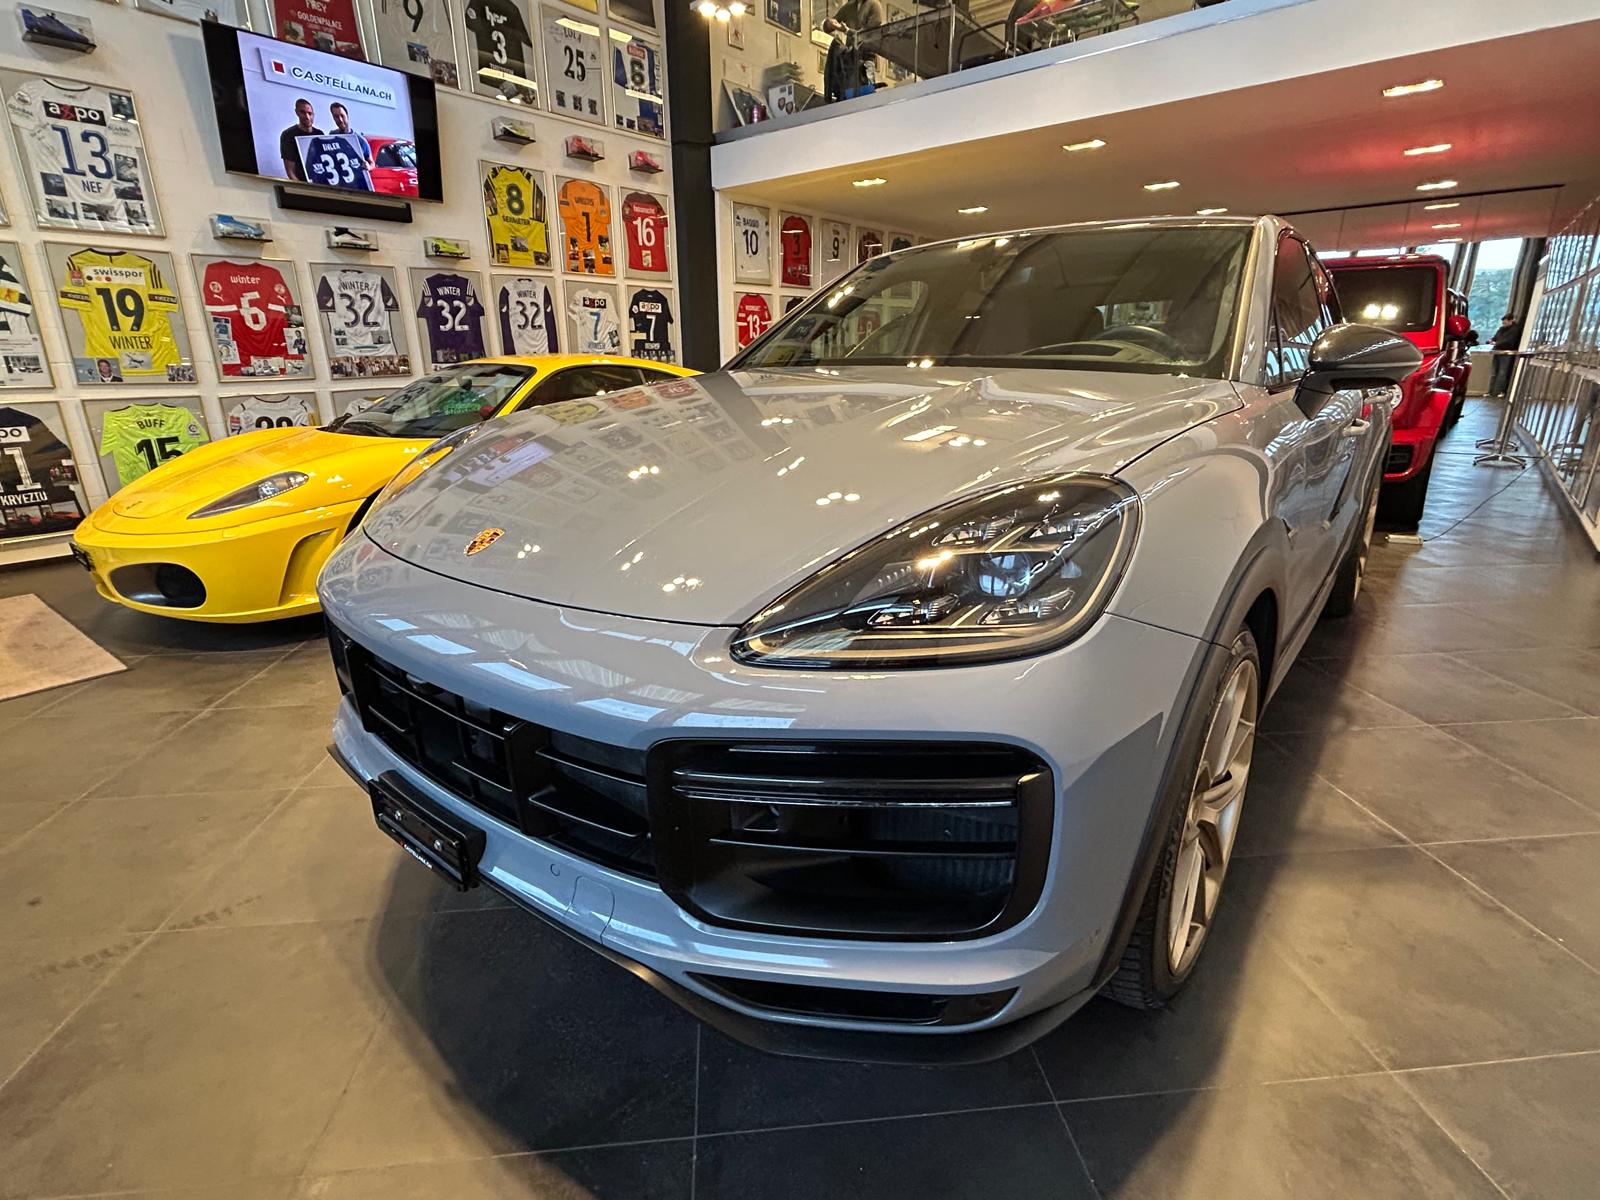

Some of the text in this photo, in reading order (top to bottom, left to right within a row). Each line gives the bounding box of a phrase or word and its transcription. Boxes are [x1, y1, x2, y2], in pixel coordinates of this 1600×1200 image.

[491, 31, 508, 64] 3
[564, 45, 586, 82] 25
[292, 67, 392, 101] CASTELLANA.CH
[51, 124, 115, 179] 13
[321, 152, 355, 185] 33
[82, 180, 103, 193] NEF
[506, 183, 525, 216] 8
[582, 211, 592, 242] 1
[633, 217, 656, 247] 16
[742, 229, 759, 255] 10
[832, 237, 840, 259] 9
[93, 268, 144, 278] swisspor
[230, 275, 261, 285] winter
[340, 281, 370, 291] WINTER
[437, 286, 461, 296] WINTER
[516, 289, 537, 299] WINTER
[95, 287, 145, 332] 19
[239, 291, 267, 331] 6
[339, 293, 381, 328] 32
[436, 299, 470, 331] 32
[516, 300, 543, 329] 32
[589, 310, 602, 342] 7
[646, 315, 656, 342] 7
[747, 314, 760, 338] 13
[109, 335, 153, 350] WINTER
[136, 418, 166, 430] BUFF
[134, 435, 185, 472] 15
[1, 491, 48, 506] KRYEZIU
